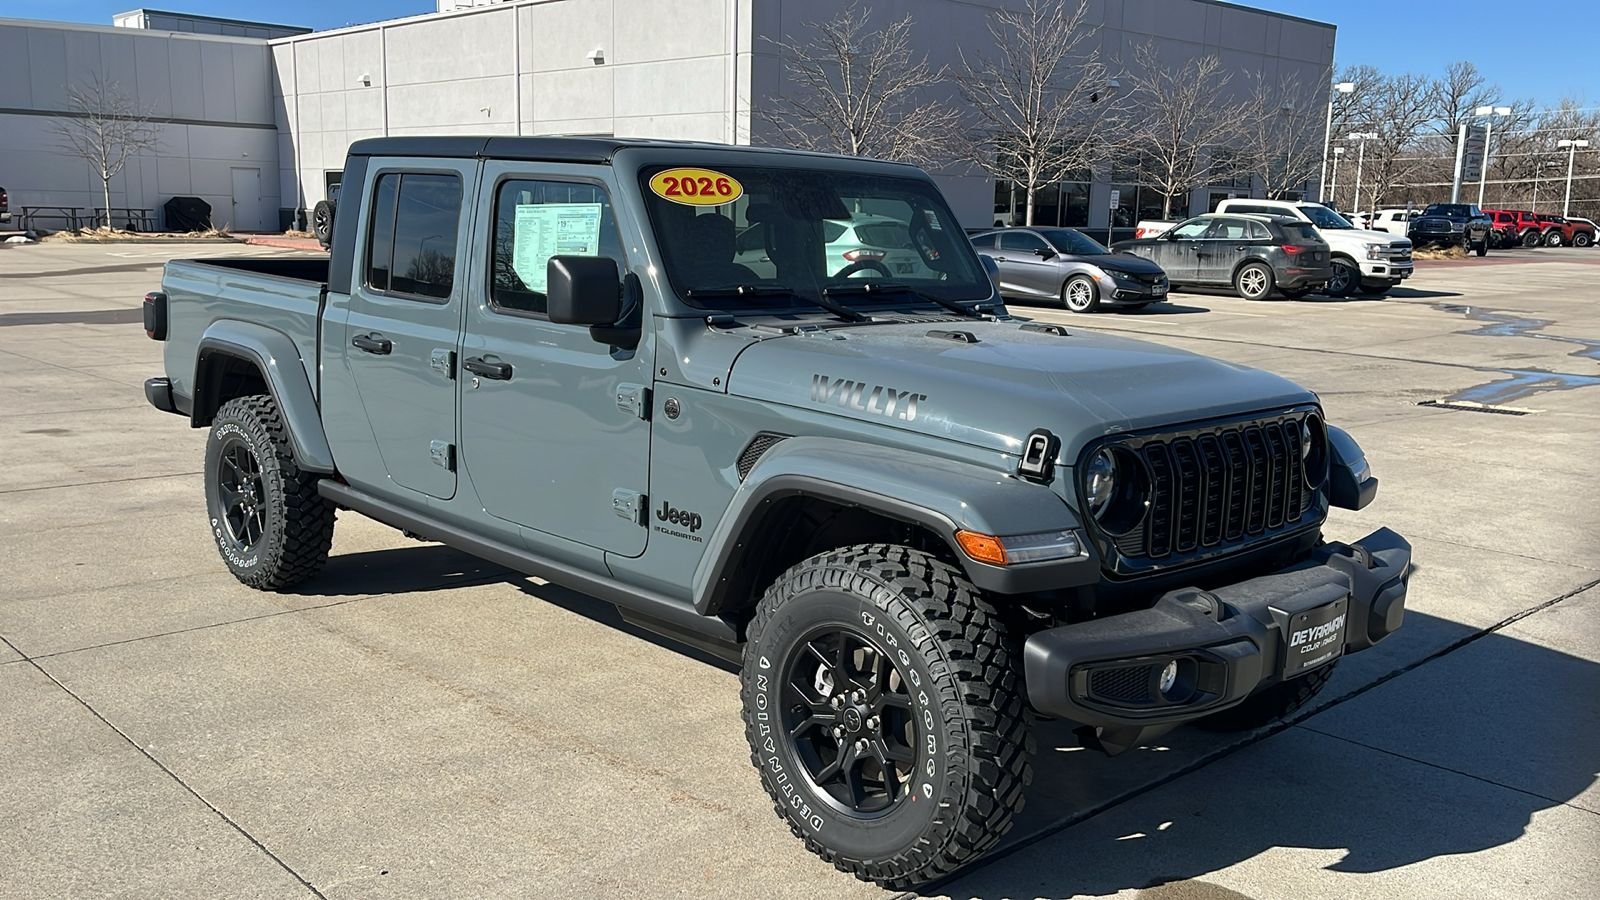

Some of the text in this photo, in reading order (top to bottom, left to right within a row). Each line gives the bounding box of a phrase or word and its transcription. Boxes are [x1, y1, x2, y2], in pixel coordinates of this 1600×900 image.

[662, 176, 733, 197] 2026
[810, 374, 928, 422] WILLYS
[656, 500, 702, 533] Jeep
[660, 527, 703, 543] GLADIATOR
[1290, 614, 1345, 646] DEYARMAN
[756, 673, 825, 833] DESTINATION
